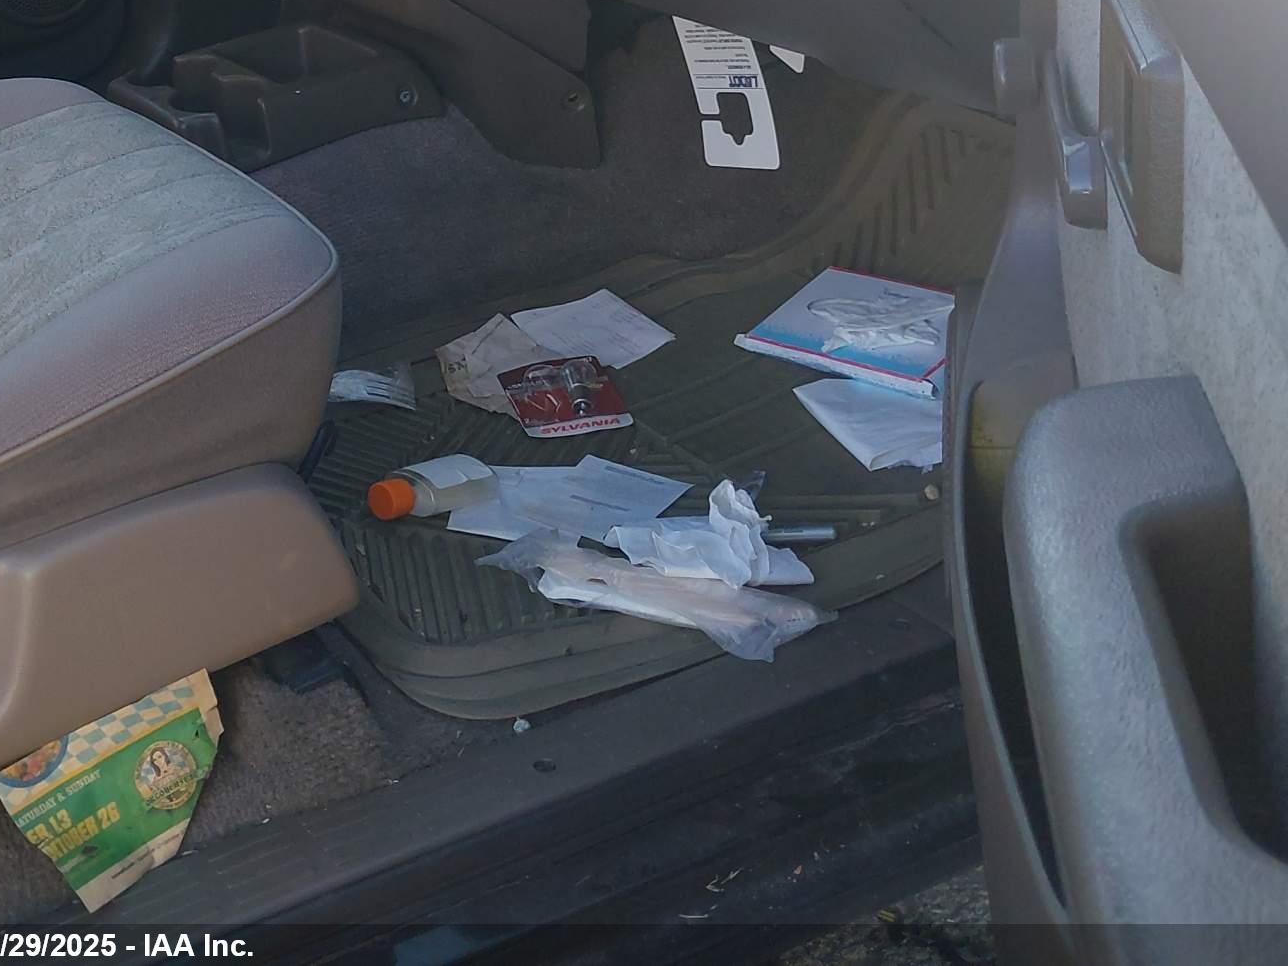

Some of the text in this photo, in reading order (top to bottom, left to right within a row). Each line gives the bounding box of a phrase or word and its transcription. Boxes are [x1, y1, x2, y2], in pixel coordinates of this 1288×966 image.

[540, 417, 622, 434] SYLVANIA
[65, 769, 101, 795] SUNDAY
[97, 801, 121, 829] 26
